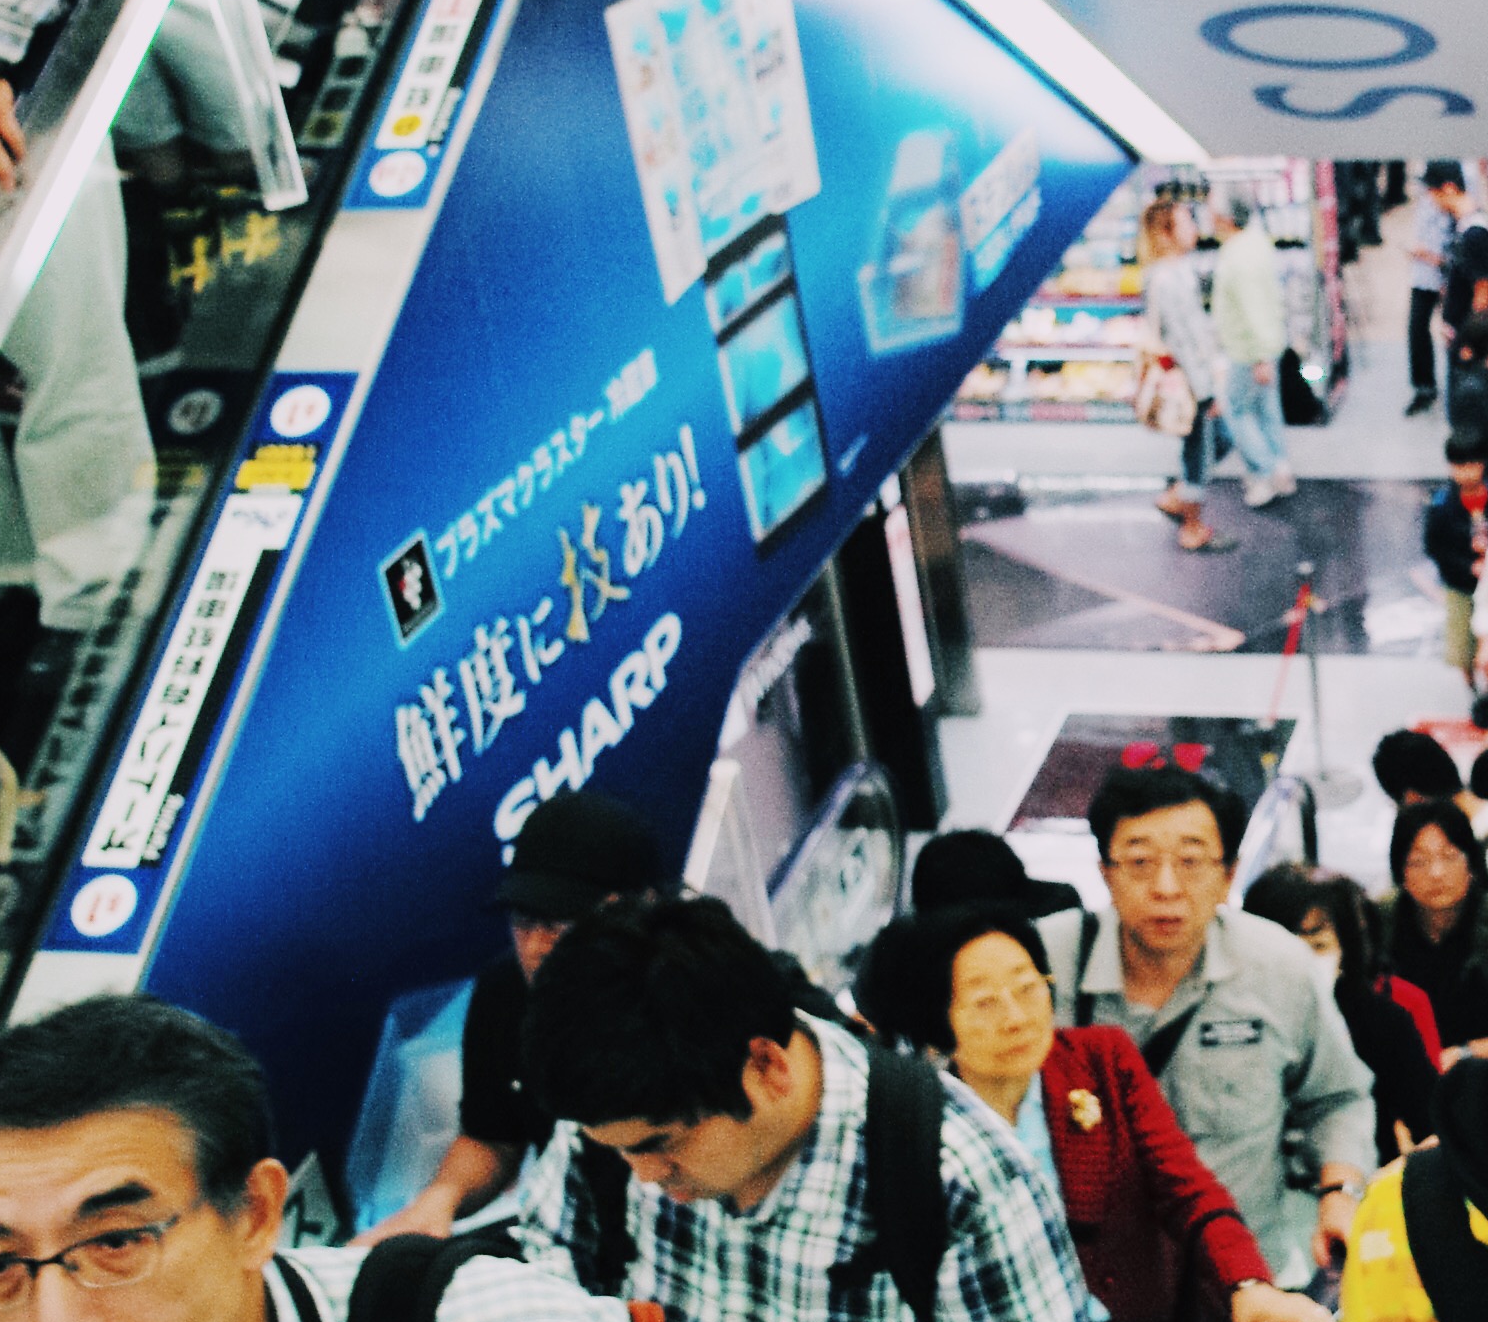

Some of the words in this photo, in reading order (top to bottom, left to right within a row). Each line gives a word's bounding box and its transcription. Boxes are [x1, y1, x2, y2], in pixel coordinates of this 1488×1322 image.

[394, 421, 708, 823] 鮮度に技あり!
[435, 407, 605, 579] プラズマクラスター
